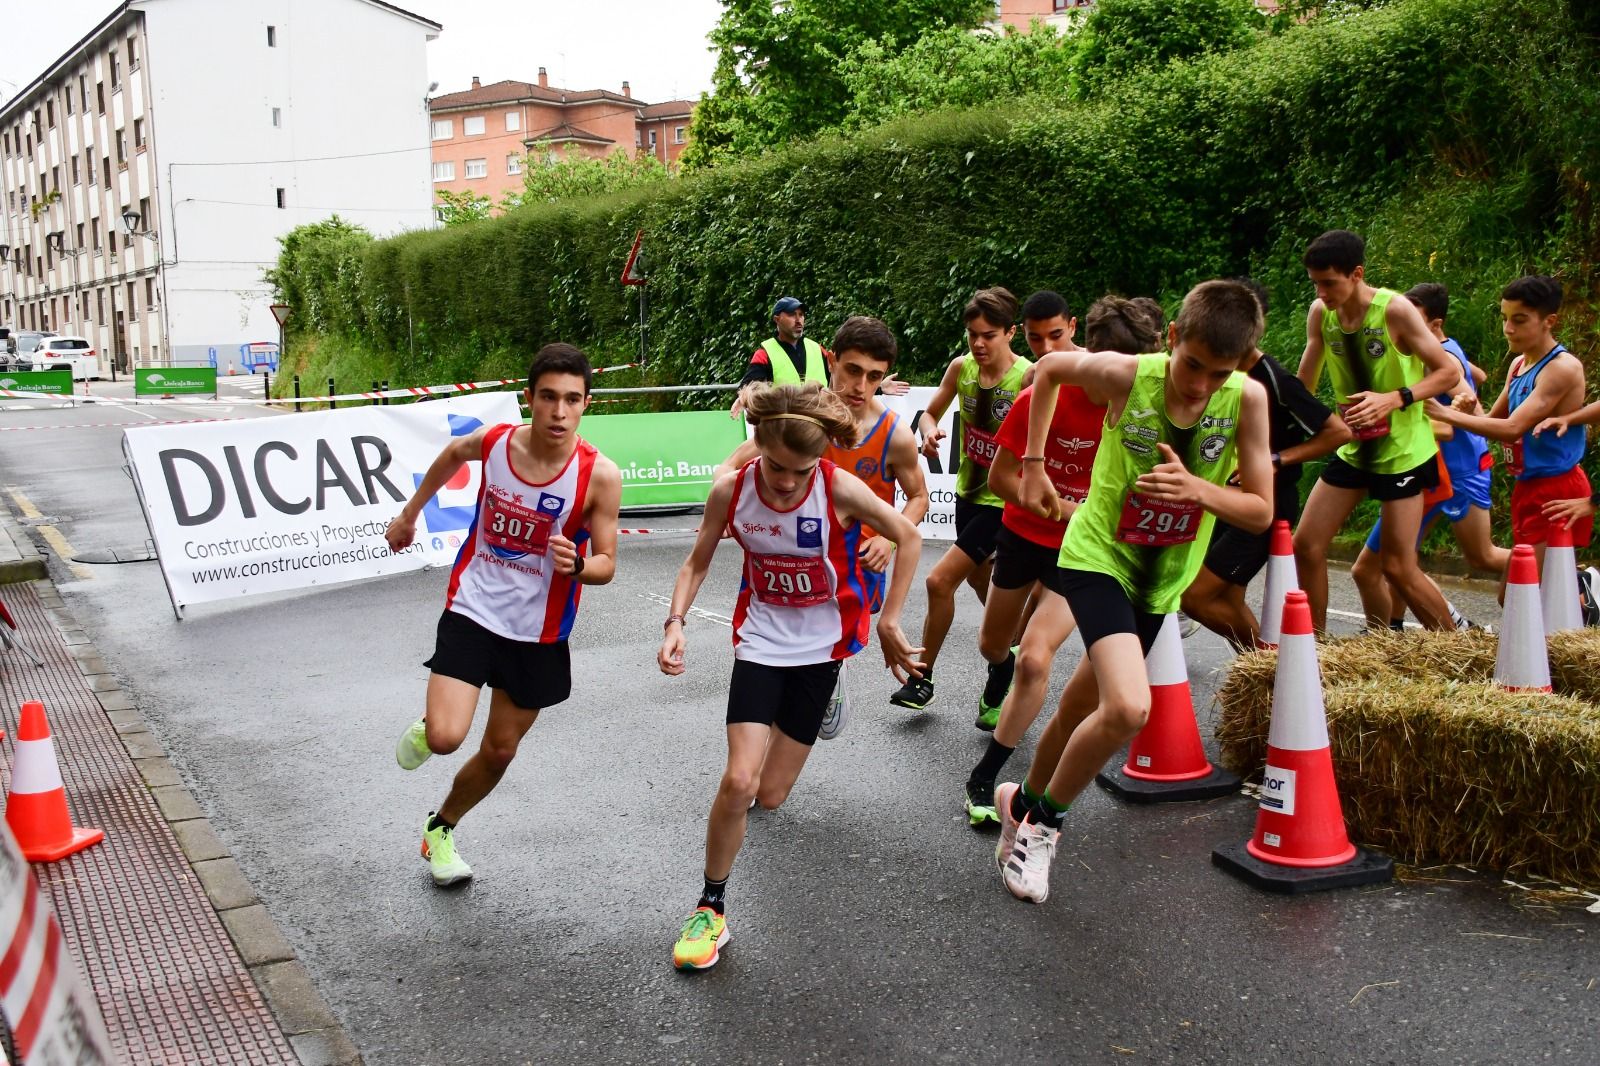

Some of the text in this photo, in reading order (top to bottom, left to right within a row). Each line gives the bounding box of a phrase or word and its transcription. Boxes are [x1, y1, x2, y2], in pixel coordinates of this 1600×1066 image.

[17, 384, 41, 392] Unicaja
[969, 435, 995, 459] 295
[159, 435, 408, 527] DICAR
[620, 460, 721, 482] nicaja Banc
[492, 512, 535, 540] 307
[1136, 509, 1191, 533] 294
[184, 531, 309, 560] Construcciones
[310, 531, 320, 548] y
[763, 571, 812, 594] 290
[1263, 776, 1285, 791] nor
